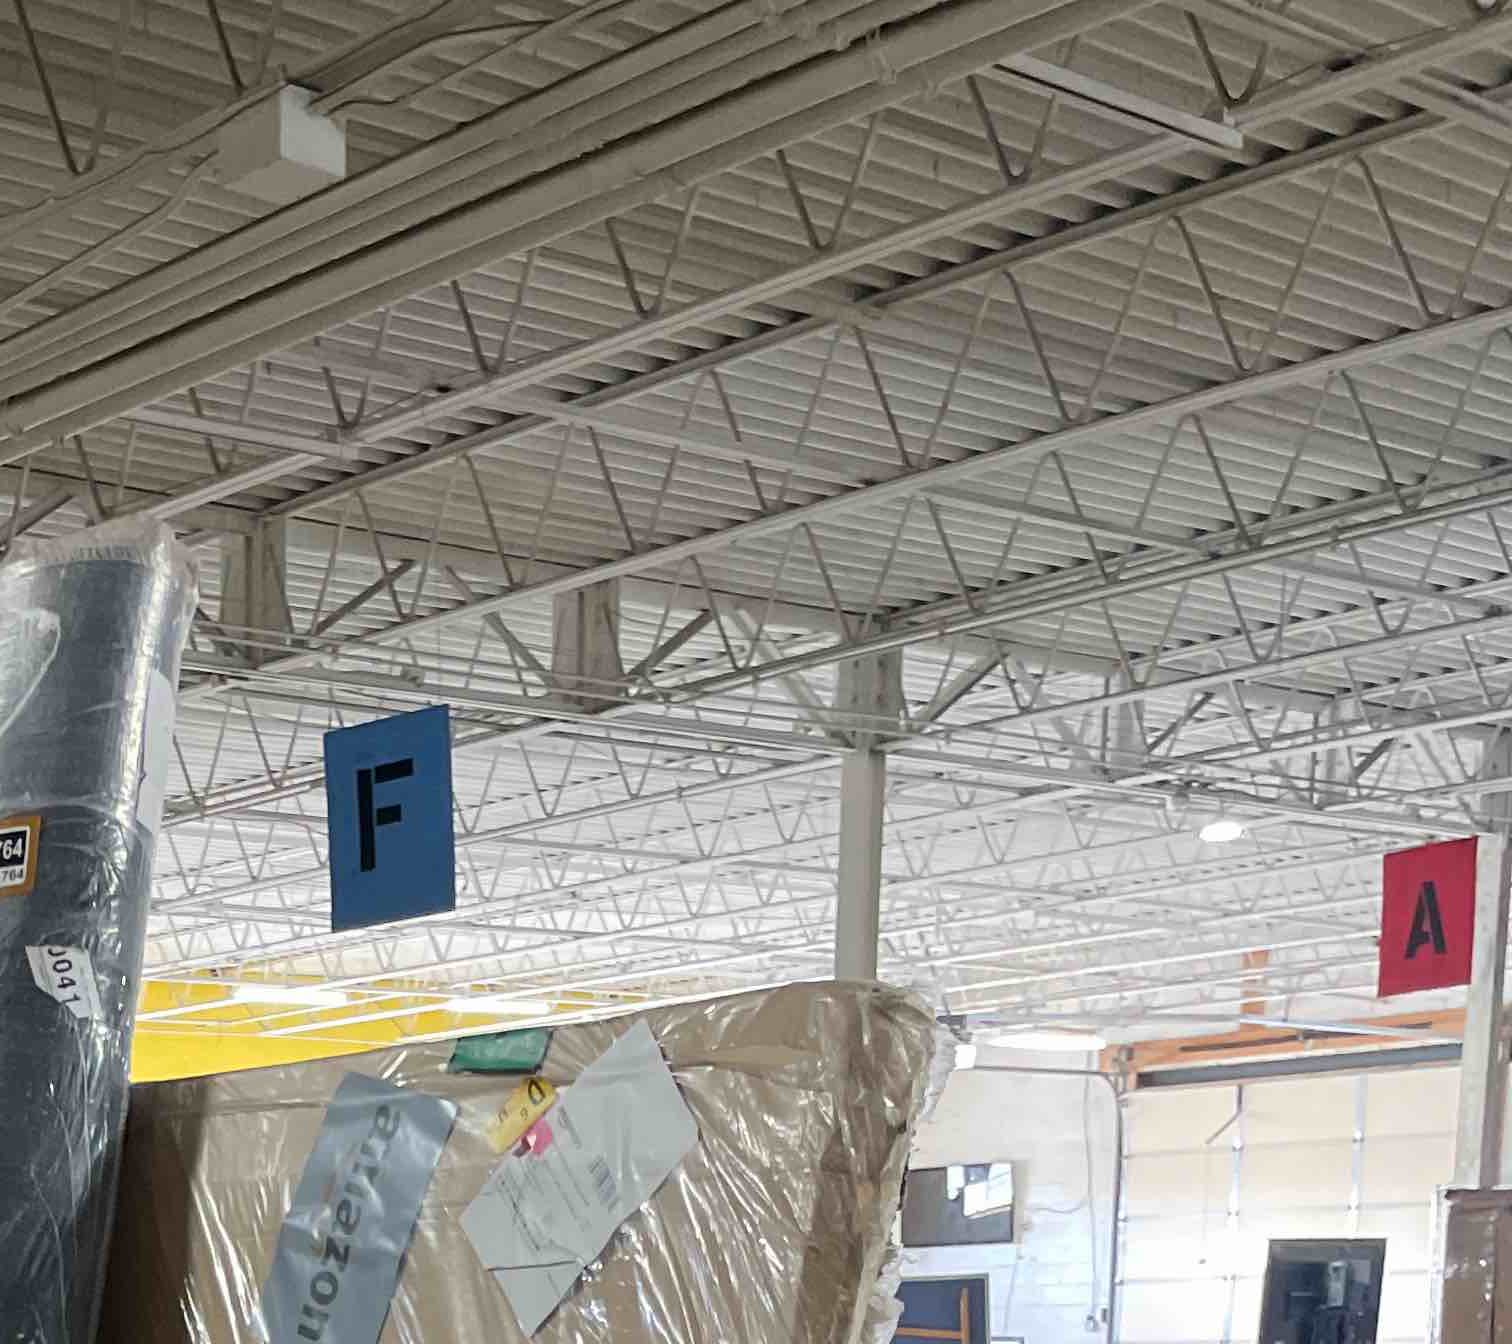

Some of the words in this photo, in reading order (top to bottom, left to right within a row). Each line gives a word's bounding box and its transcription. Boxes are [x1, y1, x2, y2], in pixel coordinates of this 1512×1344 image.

[357, 759, 414, 873] F
[1404, 881, 1446, 958] A
[48, 948, 81, 1004] J041
